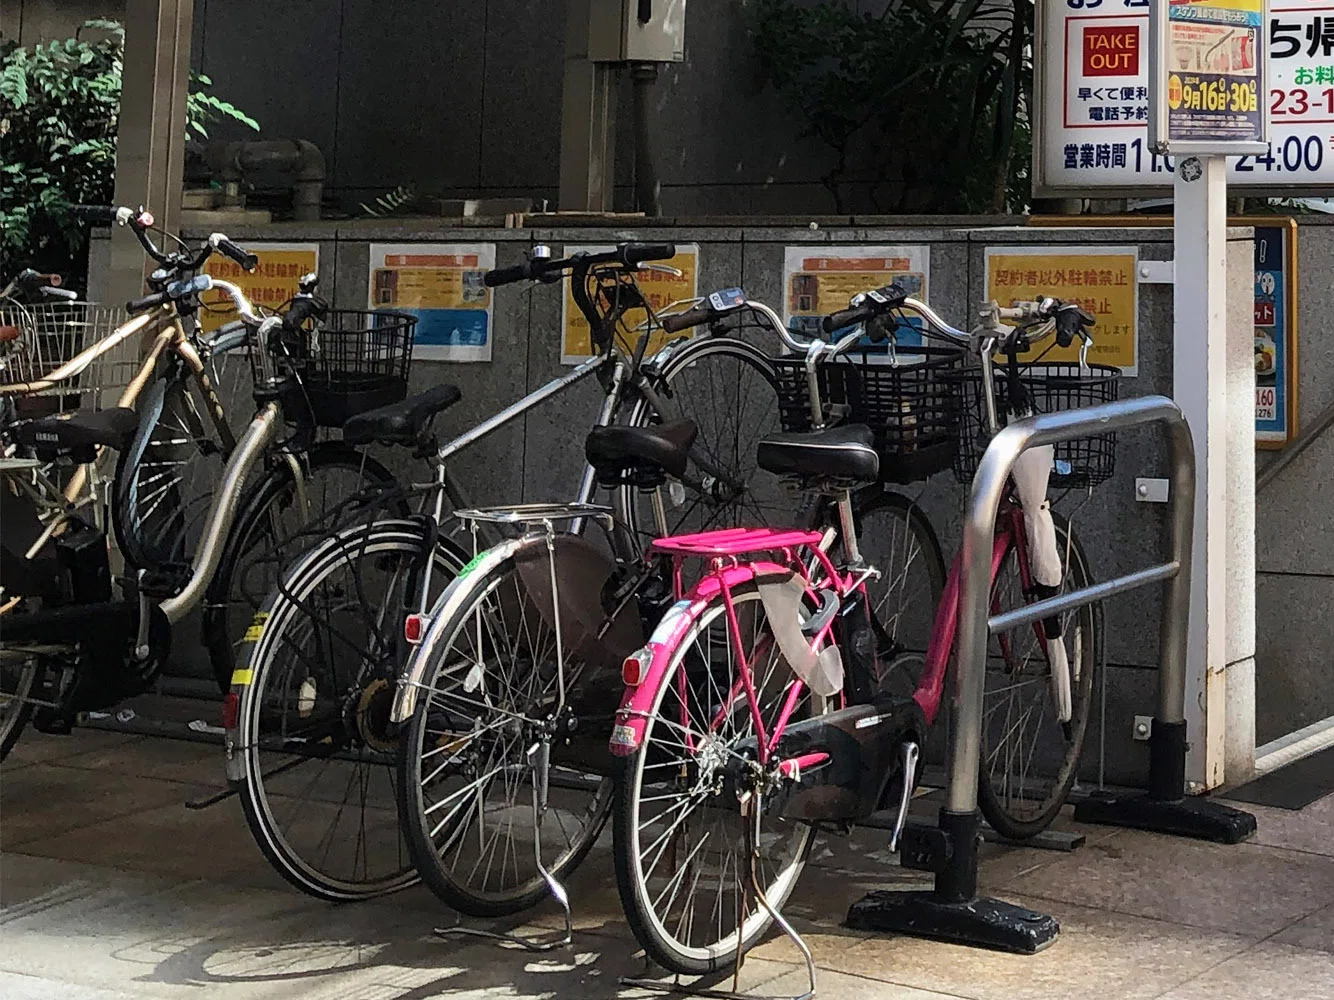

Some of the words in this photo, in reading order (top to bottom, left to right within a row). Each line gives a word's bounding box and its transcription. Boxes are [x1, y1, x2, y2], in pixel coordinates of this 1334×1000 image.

[1086, 33, 1136, 50] TAKE
[1090, 53, 1133, 69] OUT
[1064, 143, 1126, 170] 営業時間
[994, 269, 1129, 287] 契約者以外駐輪禁止
